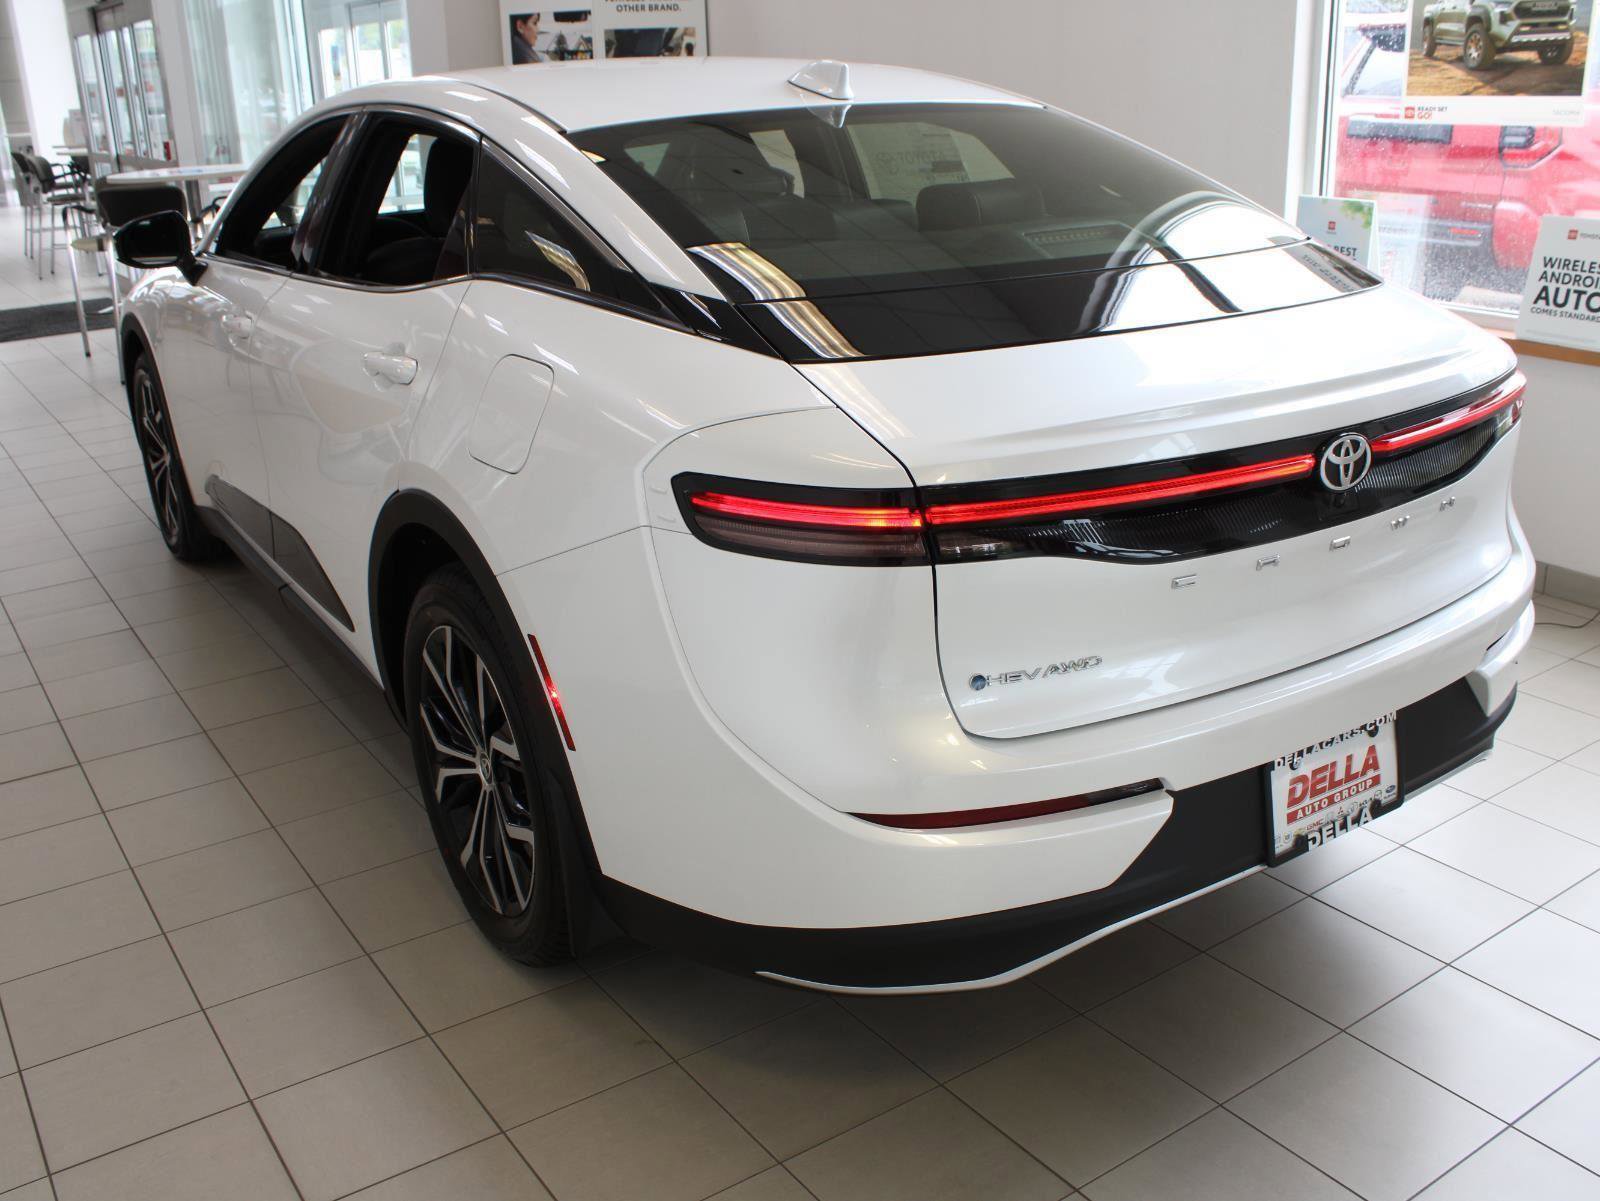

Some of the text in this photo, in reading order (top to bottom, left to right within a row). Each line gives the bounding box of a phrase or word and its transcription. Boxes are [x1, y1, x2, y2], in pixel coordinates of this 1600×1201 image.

[616, 3, 682, 13] OTHER BRAND.
[1538, 270, 1600, 289] ANDROI
[1530, 306, 1558, 317] COMES
[1533, 285, 1600, 313] AUTO
[1171, 496, 1456, 589] CROWN
[986, 655, 1103, 686] HEV AWD
[1275, 711, 1397, 767] DELLACARS.COM
[1287, 744, 1380, 809] DELLA
[1296, 779, 1373, 820] AUTO GROUP
[1307, 807, 1373, 853] DELLA
